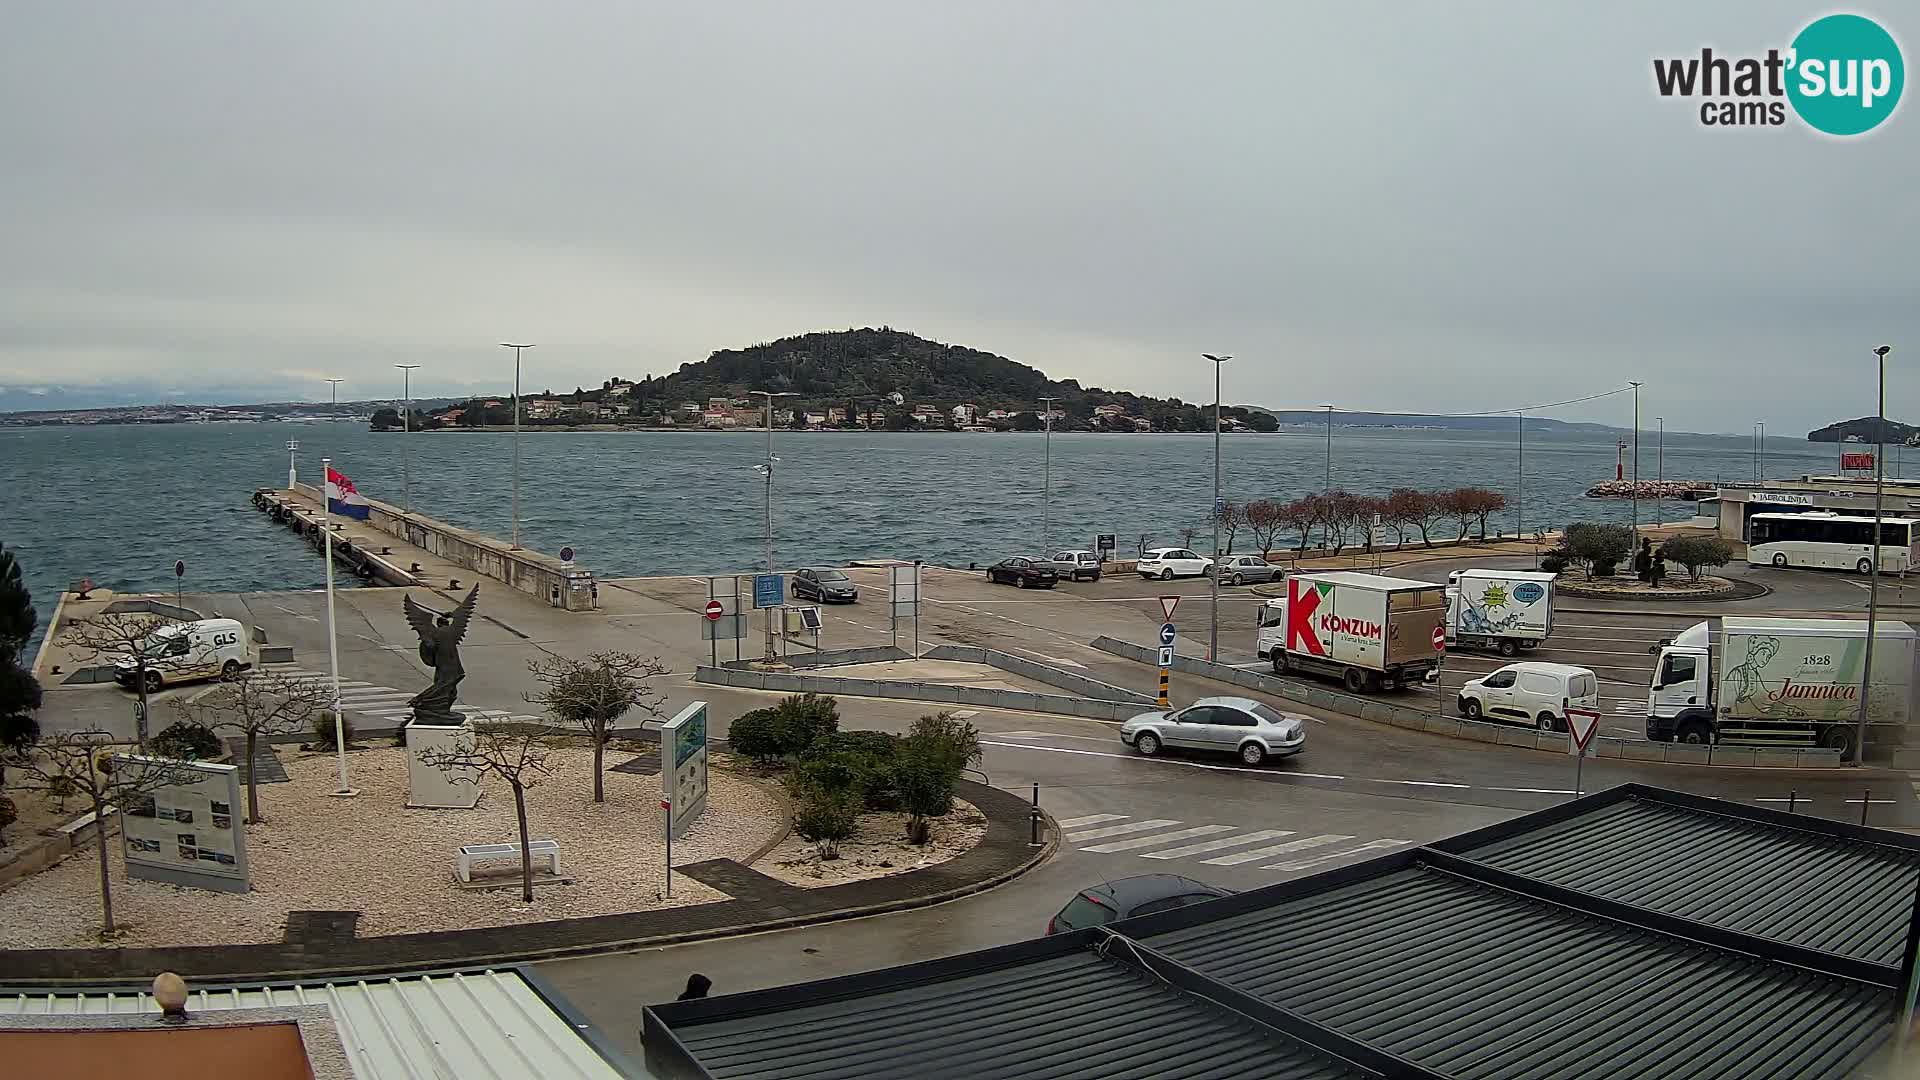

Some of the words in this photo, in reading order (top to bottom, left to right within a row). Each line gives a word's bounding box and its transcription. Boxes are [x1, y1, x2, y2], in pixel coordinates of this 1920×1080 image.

[1320, 614, 1382, 640] KONZUM
[213, 632, 236, 646] GLS
[1803, 654, 1831, 666] 1828
[1768, 677, 1857, 701] Jamnica
